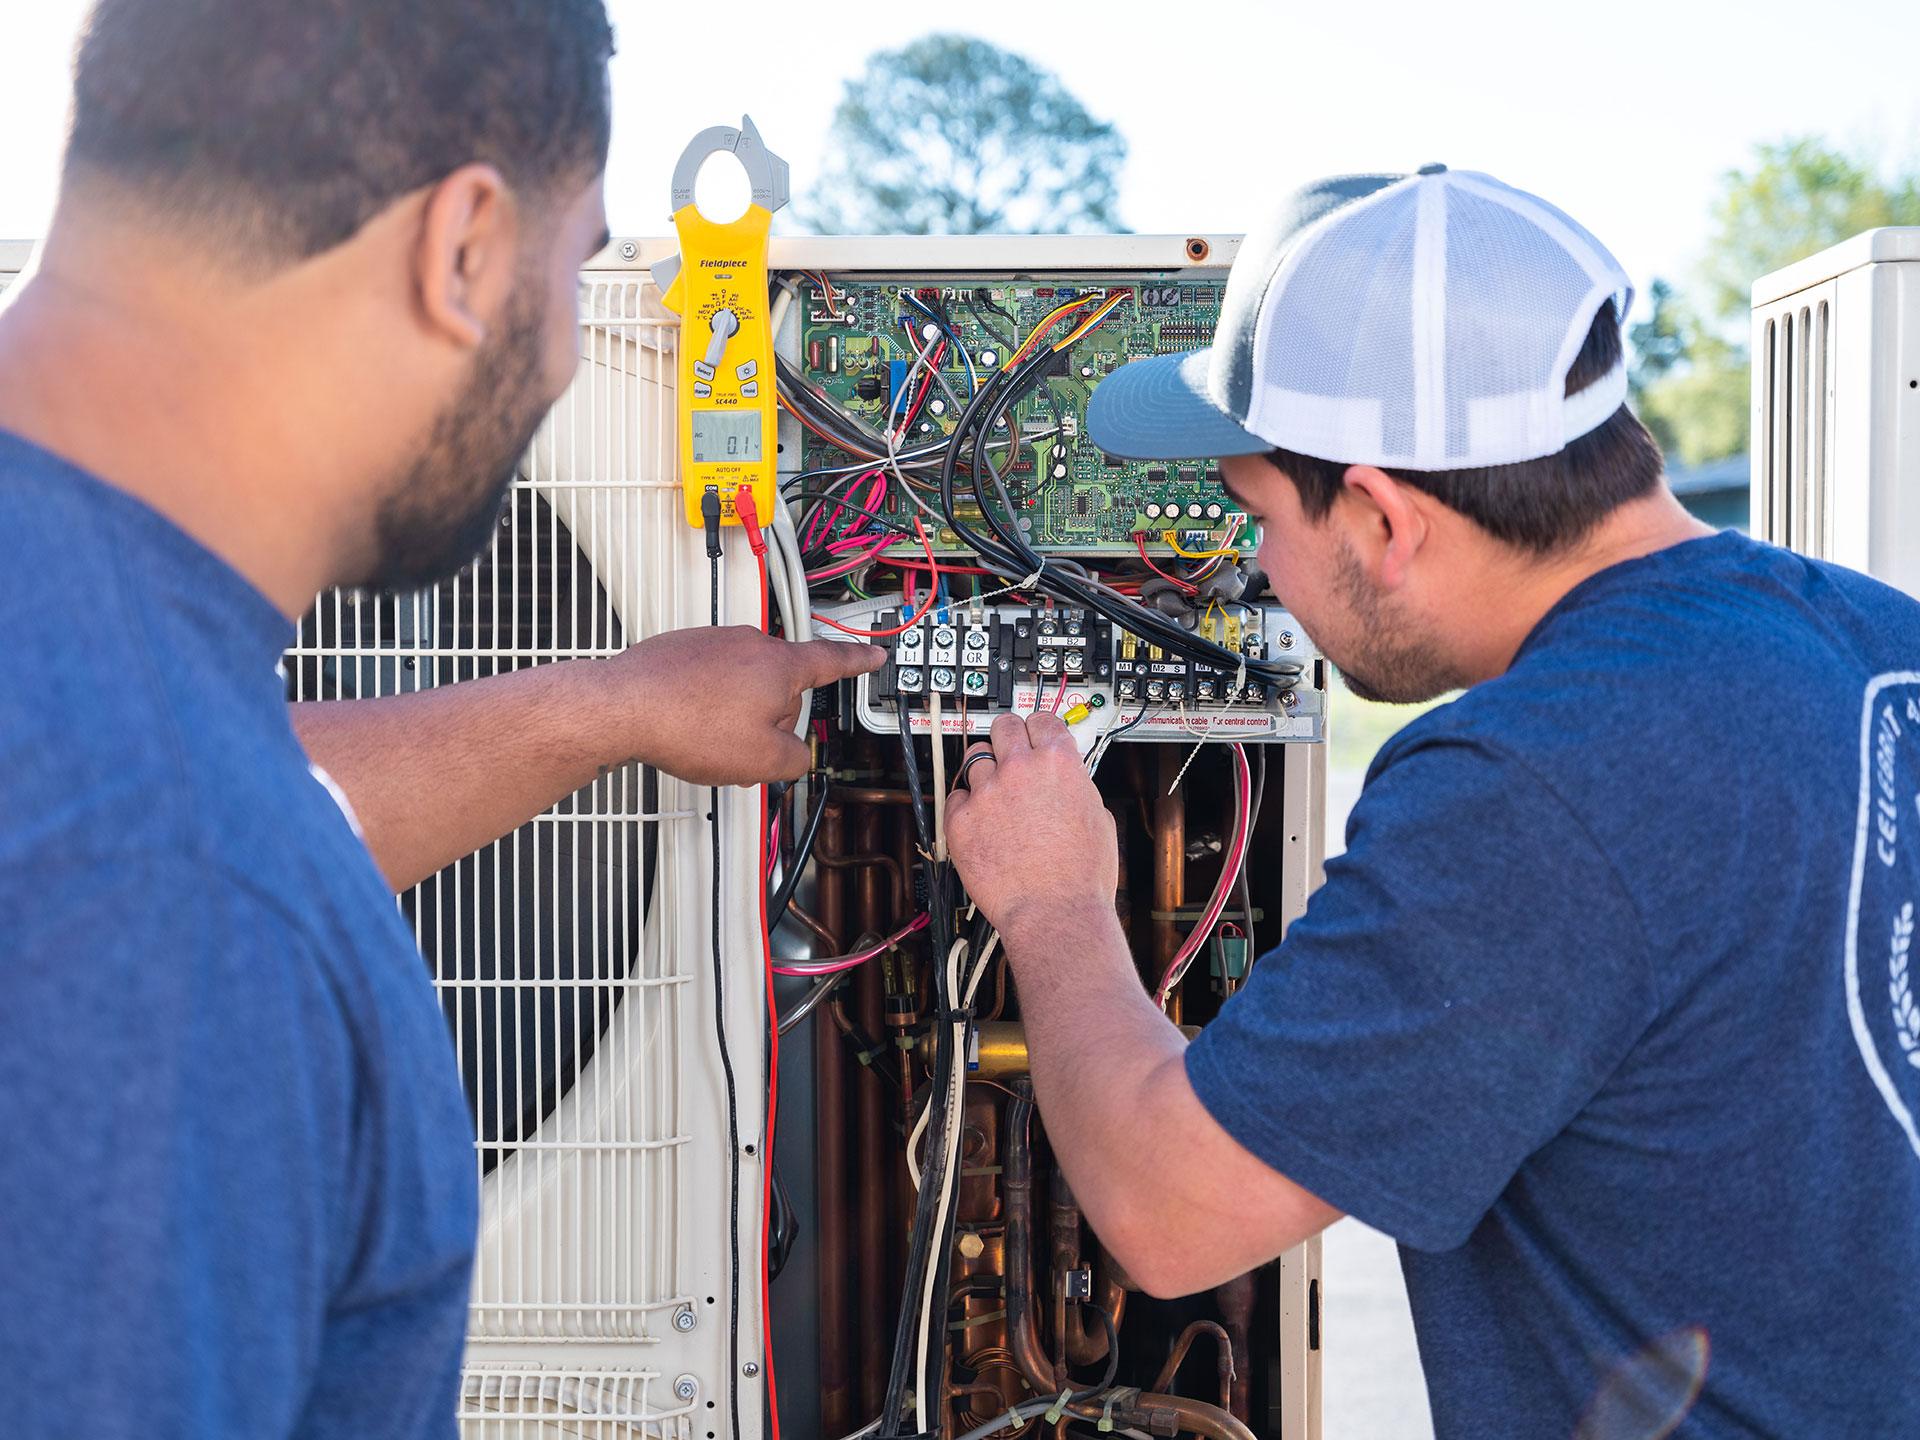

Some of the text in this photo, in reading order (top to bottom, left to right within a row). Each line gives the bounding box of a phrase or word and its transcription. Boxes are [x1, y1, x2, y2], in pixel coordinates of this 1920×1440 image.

[700, 260, 747, 269] Fieldpiece
[696, 367, 712, 376] Select
[727, 436, 749, 455] 0.1
[1041, 637, 1079, 645] B1 B2
[904, 652, 917, 663] L1
[936, 652, 950, 663] L2
[966, 652, 983, 664] GR
[1118, 663, 1131, 671] M1
[1152, 664, 1181, 673] M2 S
[907, 717, 919, 726] For
[920, 718, 930, 726] the
[1120, 715, 1132, 724] For
[1144, 716, 1190, 725] ommunicatin
[1191, 716, 1208, 725] cable
[1224, 717, 1246, 725] central
[1246, 717, 1269, 725] control
